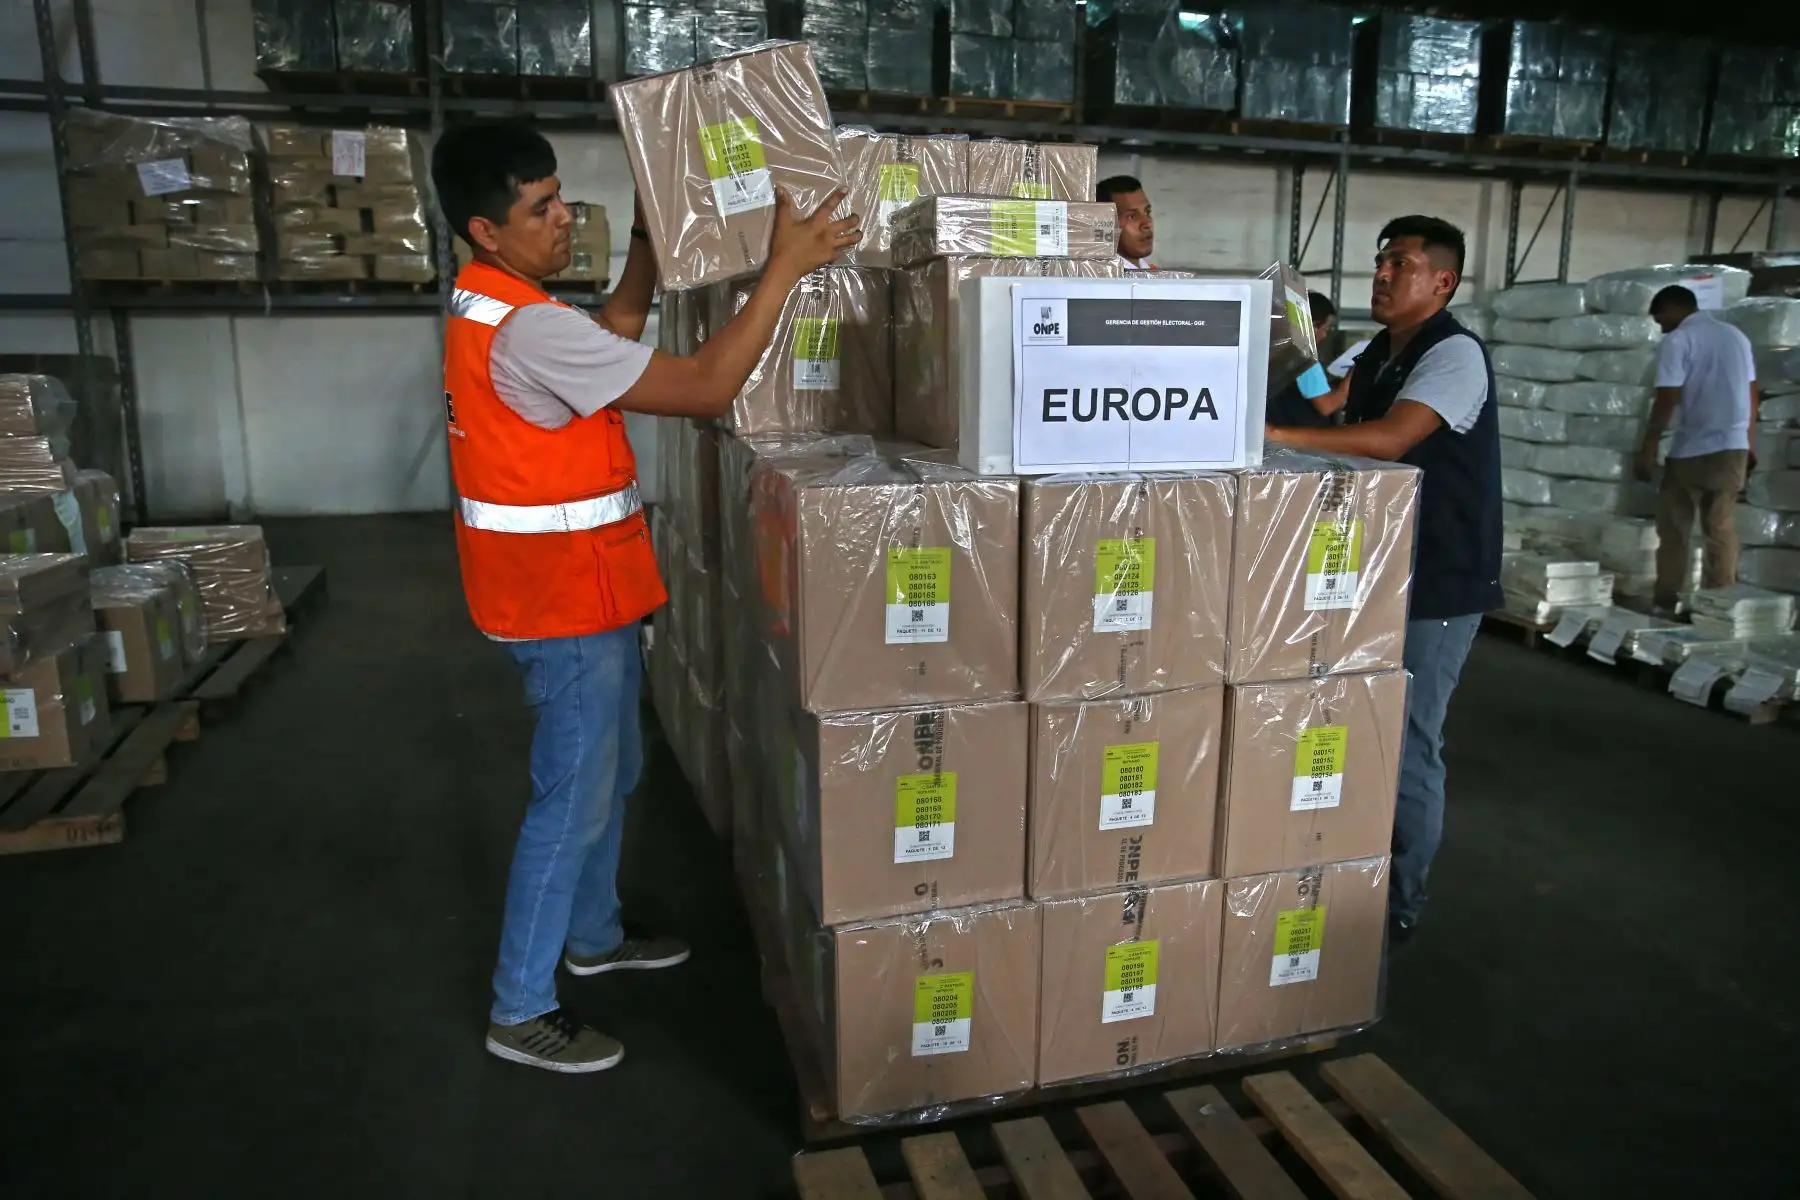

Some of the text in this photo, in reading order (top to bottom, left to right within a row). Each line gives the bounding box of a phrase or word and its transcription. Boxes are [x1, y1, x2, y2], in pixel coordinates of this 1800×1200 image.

[1034, 322, 1060, 335] ONPE
[1042, 388, 1218, 422] EUROPA
[916, 813, 941, 821] 080170
